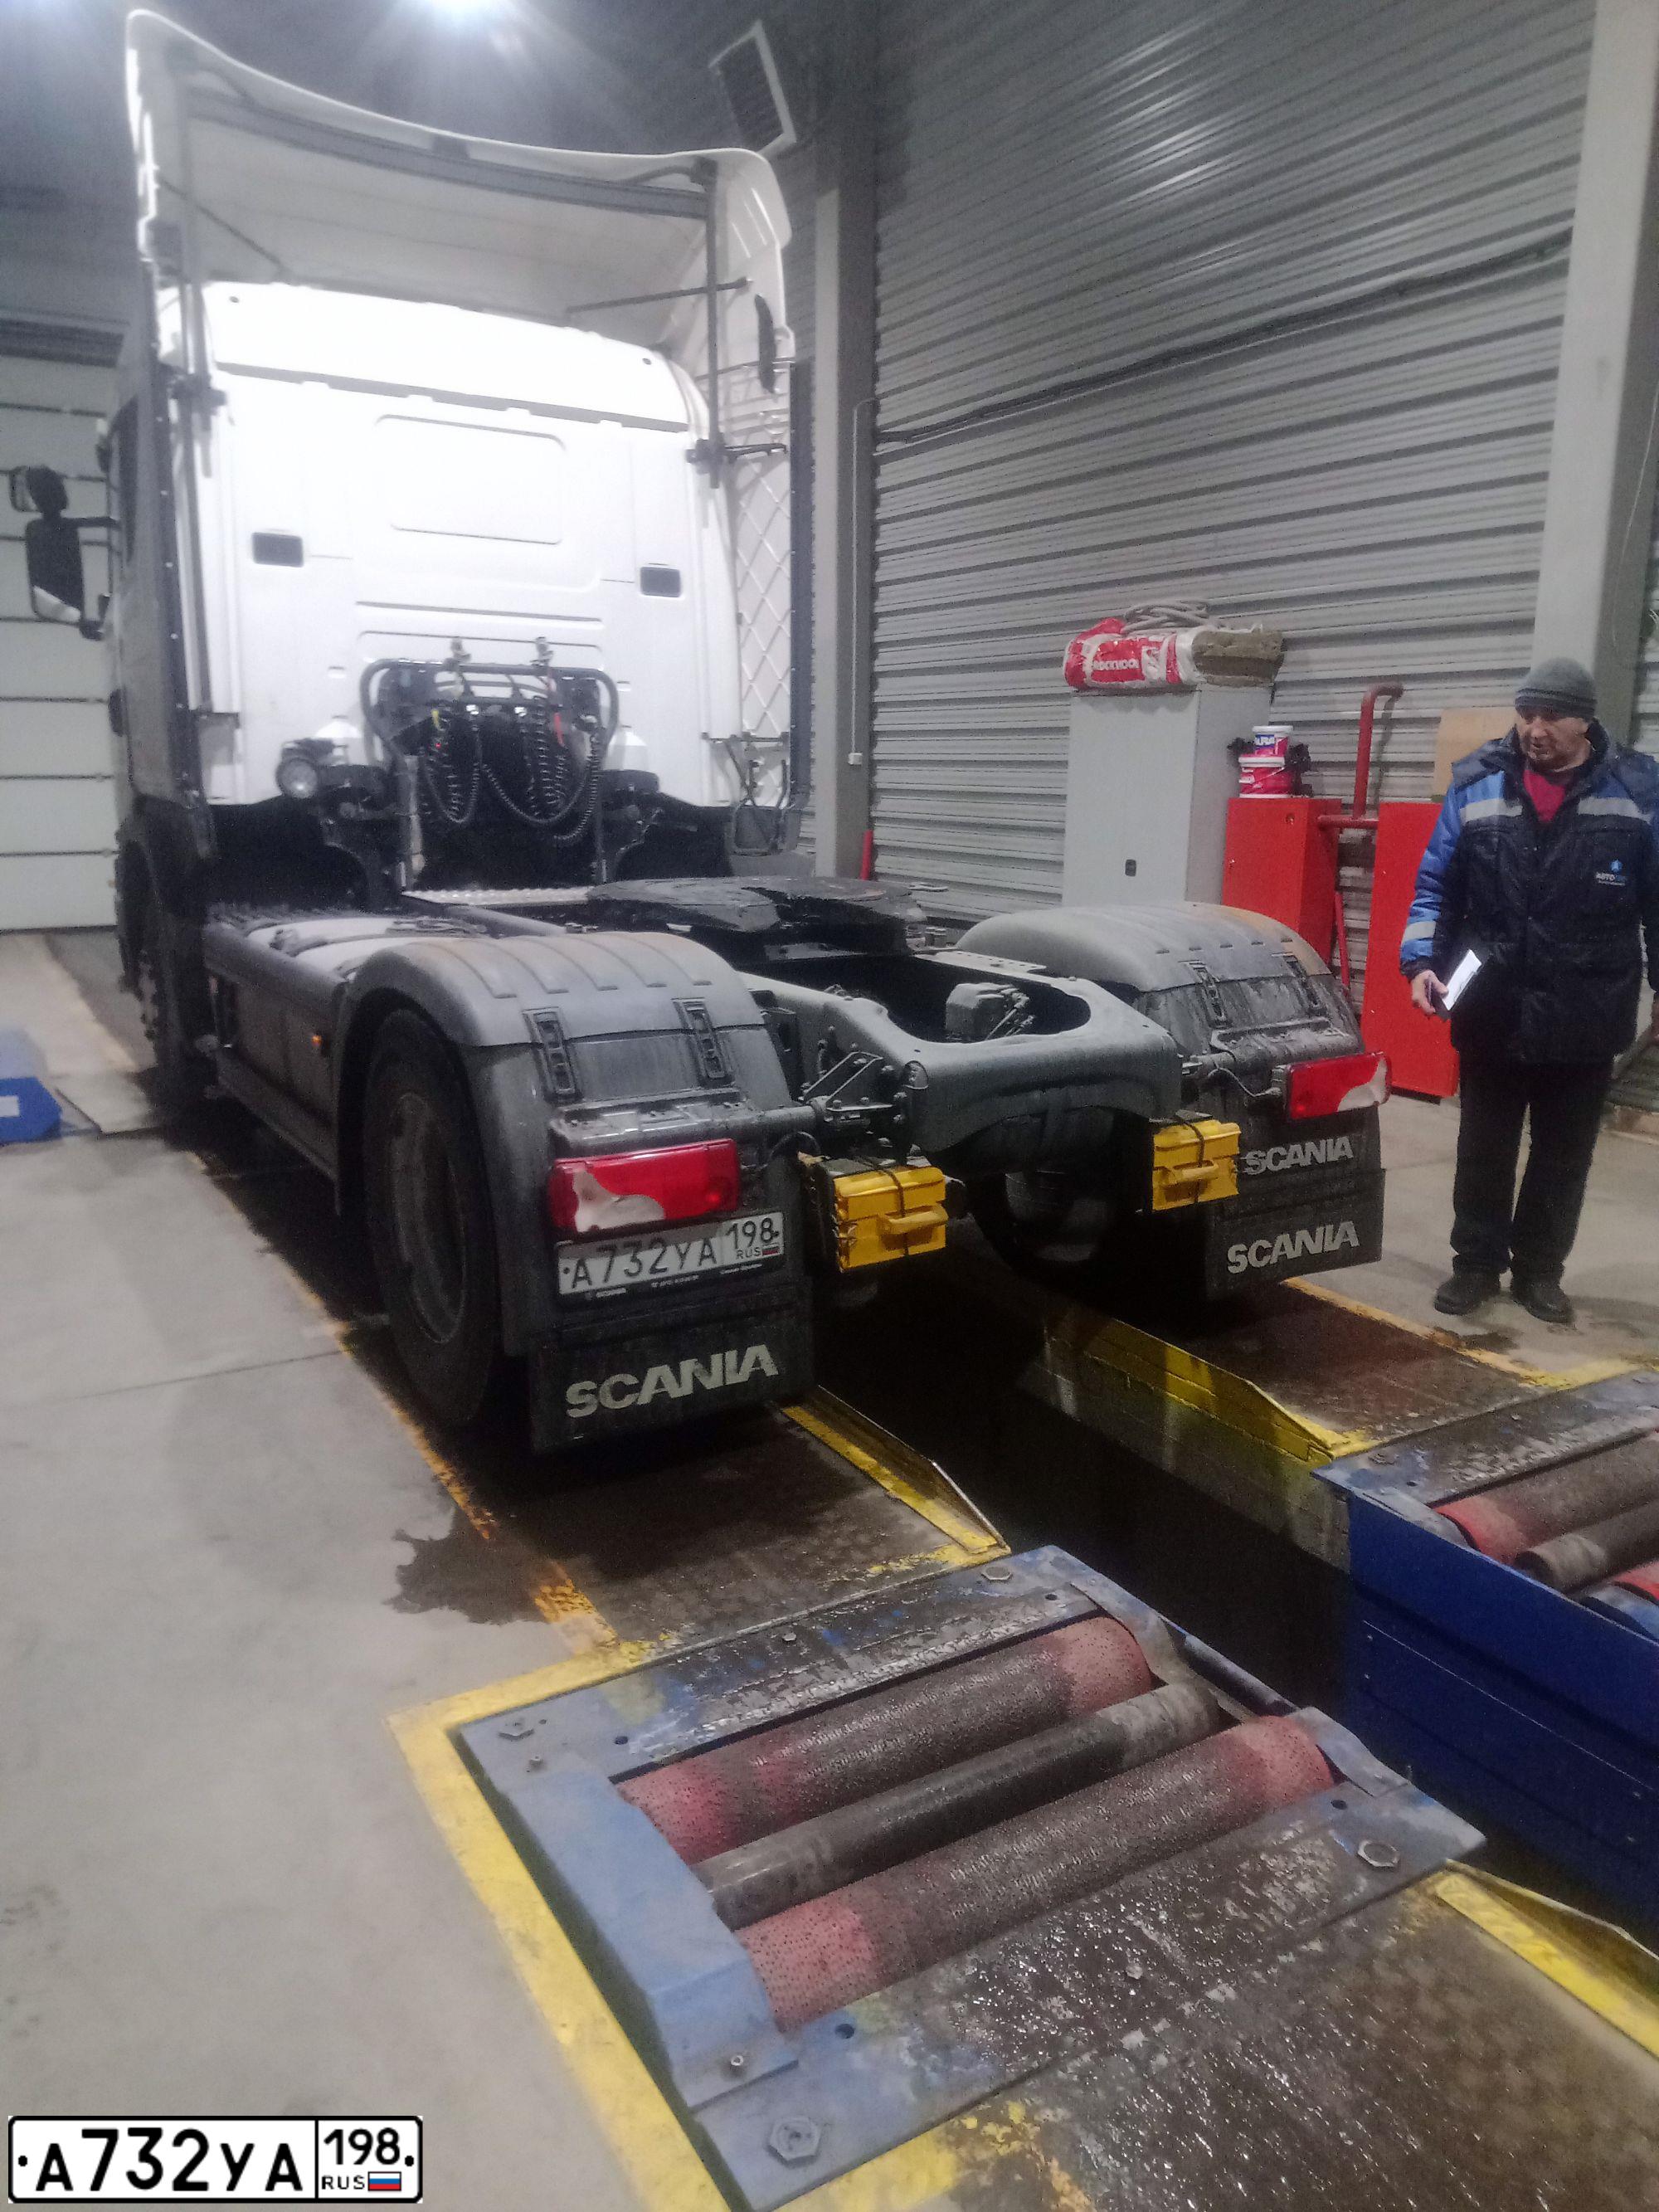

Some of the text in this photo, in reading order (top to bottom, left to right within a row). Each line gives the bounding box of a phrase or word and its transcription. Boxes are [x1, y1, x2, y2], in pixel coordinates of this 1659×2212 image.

[1243, 1136, 1354, 1176] SCANIA
[725, 1217, 774, 1250] 198
[736, 1246, 761, 1260] RUS
[1227, 1220, 1360, 1274] SCANIA
[566, 1344, 779, 1418] SCANIA
